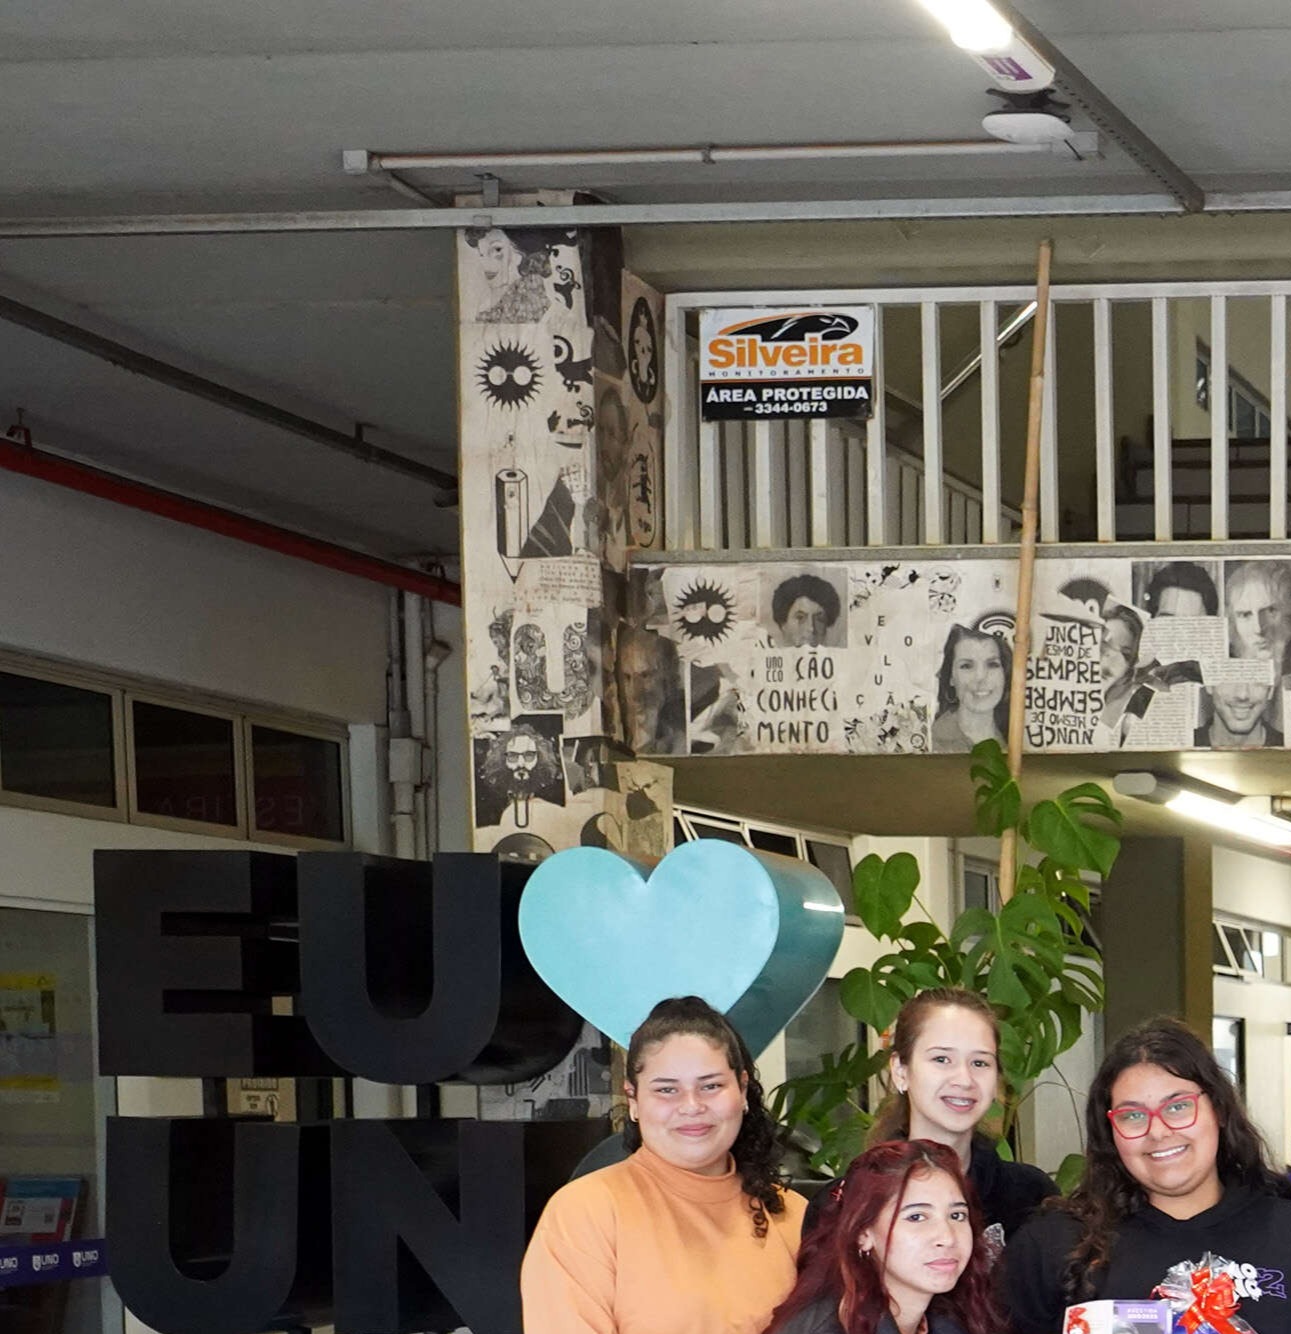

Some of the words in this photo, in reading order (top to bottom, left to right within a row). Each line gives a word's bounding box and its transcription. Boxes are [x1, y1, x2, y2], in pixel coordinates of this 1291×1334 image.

[708, 337, 863, 368] Silveira
[708, 368, 864, 377] MONITORAMENTO
[706, 386, 757, 403] ÁREA
[762, 386, 869, 402] PROTEGIDA
[757, 720, 829, 744] MENTO
[94, 849, 502, 1085] EU
